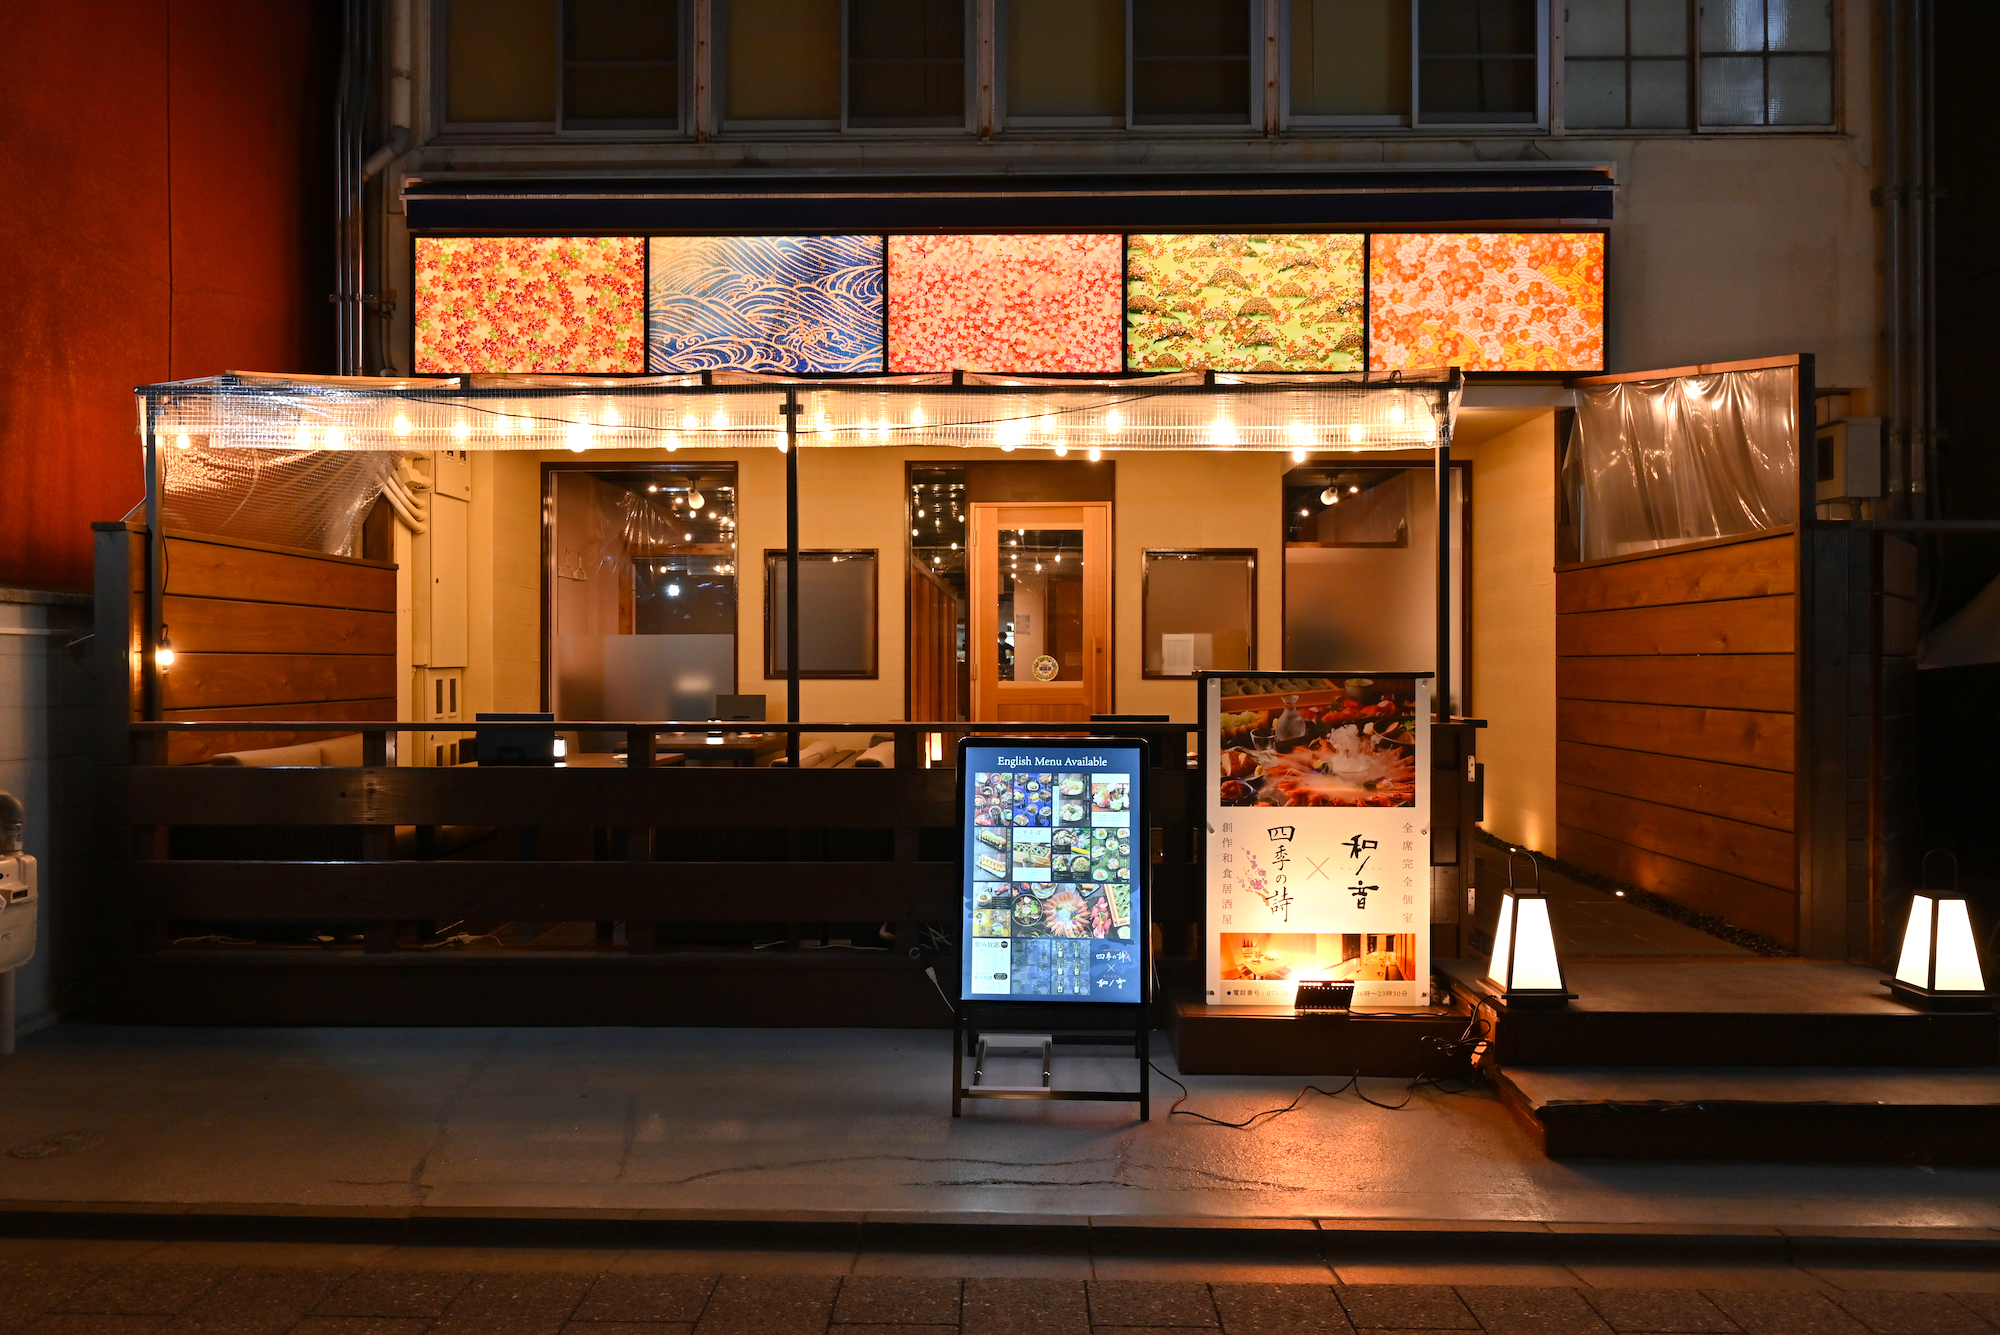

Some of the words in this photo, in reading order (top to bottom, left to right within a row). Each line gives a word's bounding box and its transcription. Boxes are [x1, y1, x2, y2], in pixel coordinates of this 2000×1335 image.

[997, 756, 1032, 768] English
[1035, 757, 1062, 766] Menu
[1064, 756, 1108, 766] Available
[1222, 822, 1233, 925] 創作和食居酒屋
[1265, 826, 1296, 923] 四季の詩
[1402, 822, 1414, 924] 全席完全個室
